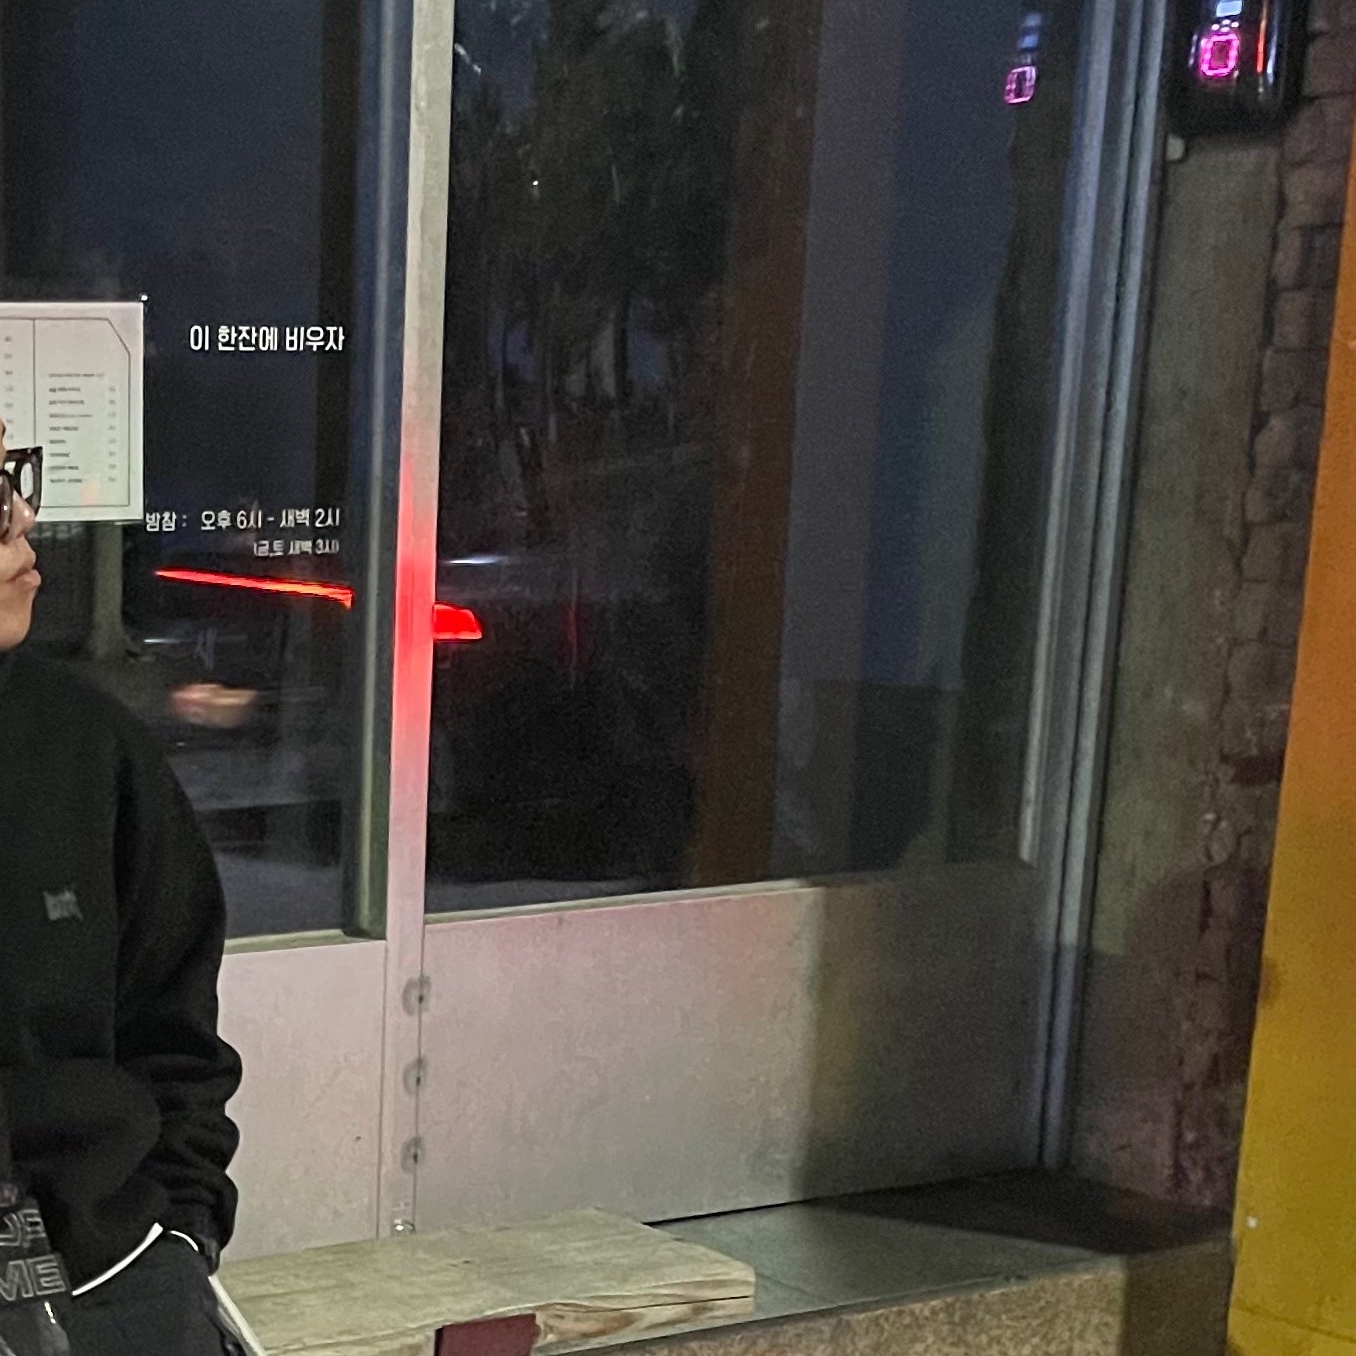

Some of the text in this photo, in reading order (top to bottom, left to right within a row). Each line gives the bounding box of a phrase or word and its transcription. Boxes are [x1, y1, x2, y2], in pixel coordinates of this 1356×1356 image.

[190, 325, 345, 351] 이 한잔에 비우자
[201, 509, 232, 531] 오후
[236, 509, 262, 530] 6시
[280, 508, 310, 528] 새벽
[315, 507, 341, 528] 2시
